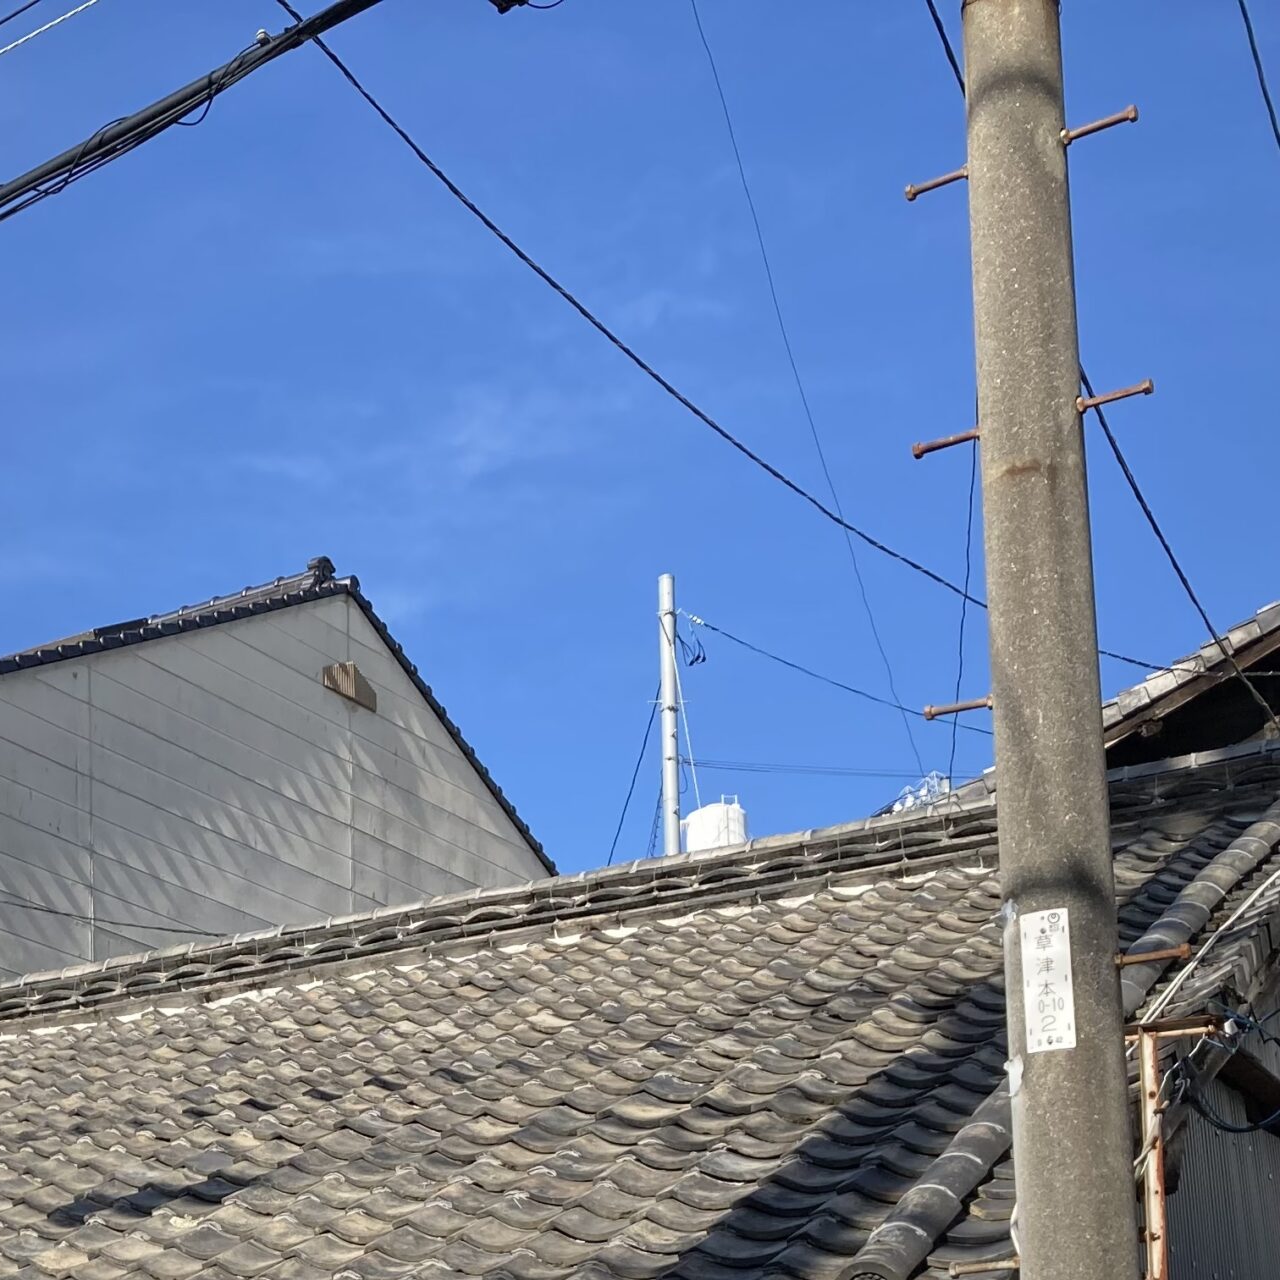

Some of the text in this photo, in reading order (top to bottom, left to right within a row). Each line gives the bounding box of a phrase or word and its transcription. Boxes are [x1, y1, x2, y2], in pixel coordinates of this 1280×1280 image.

[1034, 934, 1056, 997] 草津本
[1040, 1014, 1057, 1033] 2
